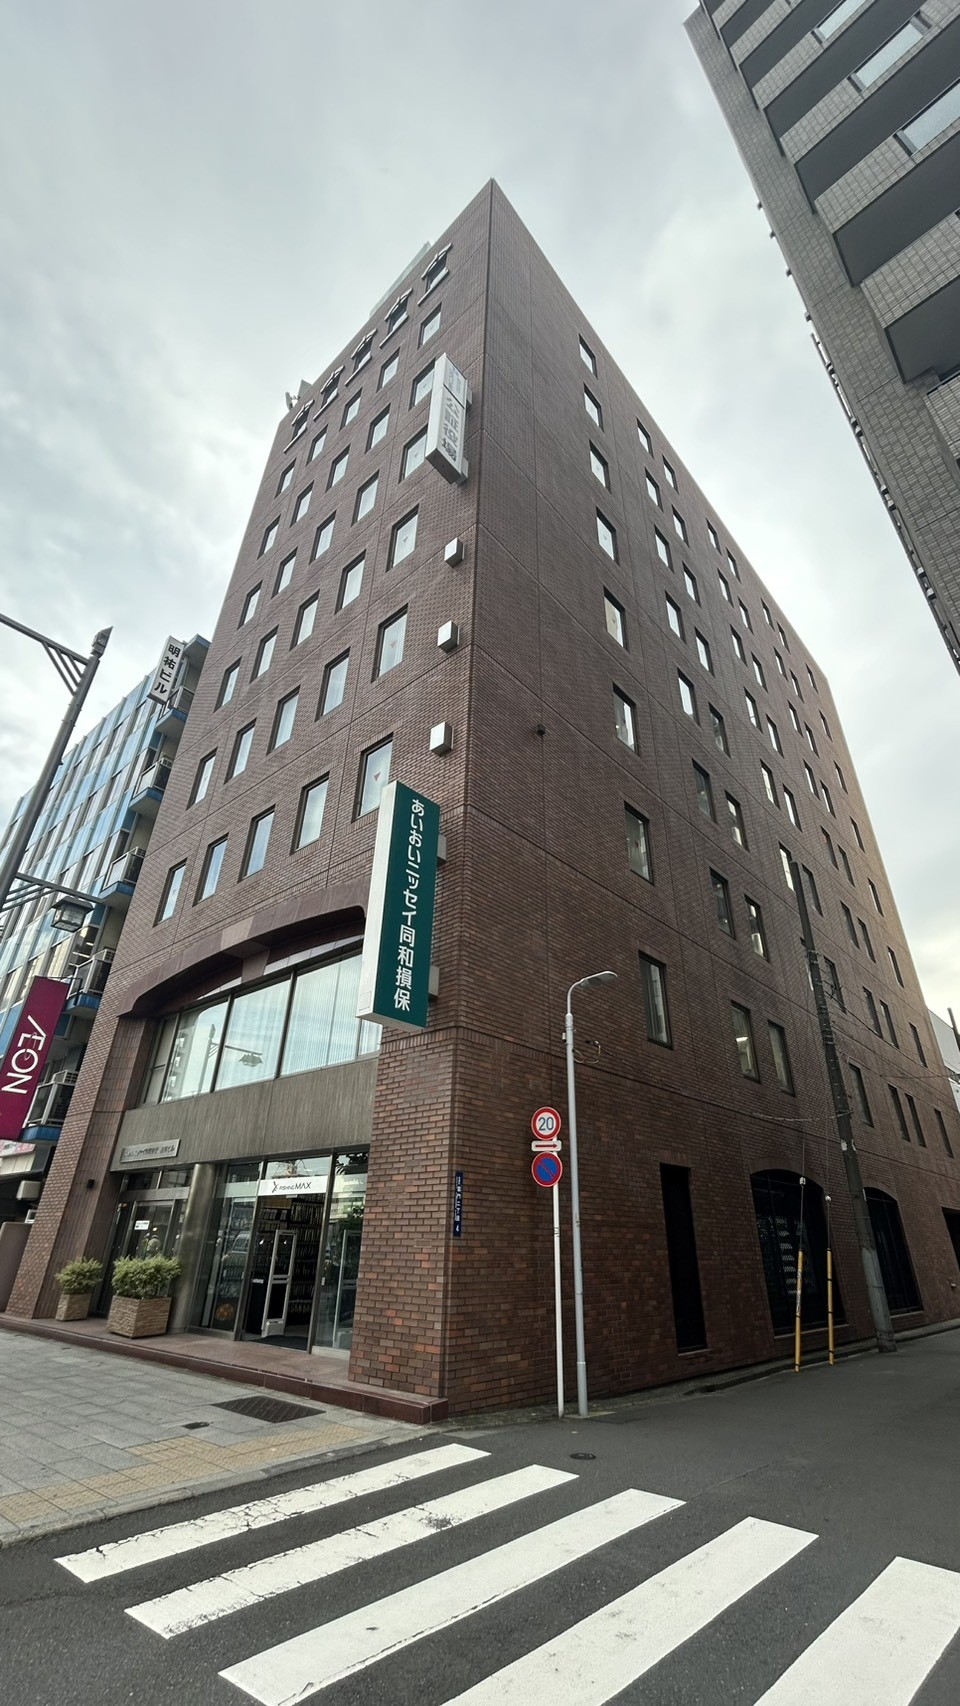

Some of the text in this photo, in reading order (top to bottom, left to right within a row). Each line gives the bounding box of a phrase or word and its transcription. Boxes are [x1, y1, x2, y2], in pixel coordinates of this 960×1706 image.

[154, 643, 181, 694] 明祐ビル
[394, 799, 425, 1012] あいおいニッセイ同和損保
[1, 1014, 47, 1094] AEON
[538, 1116, 554, 1131] 20
